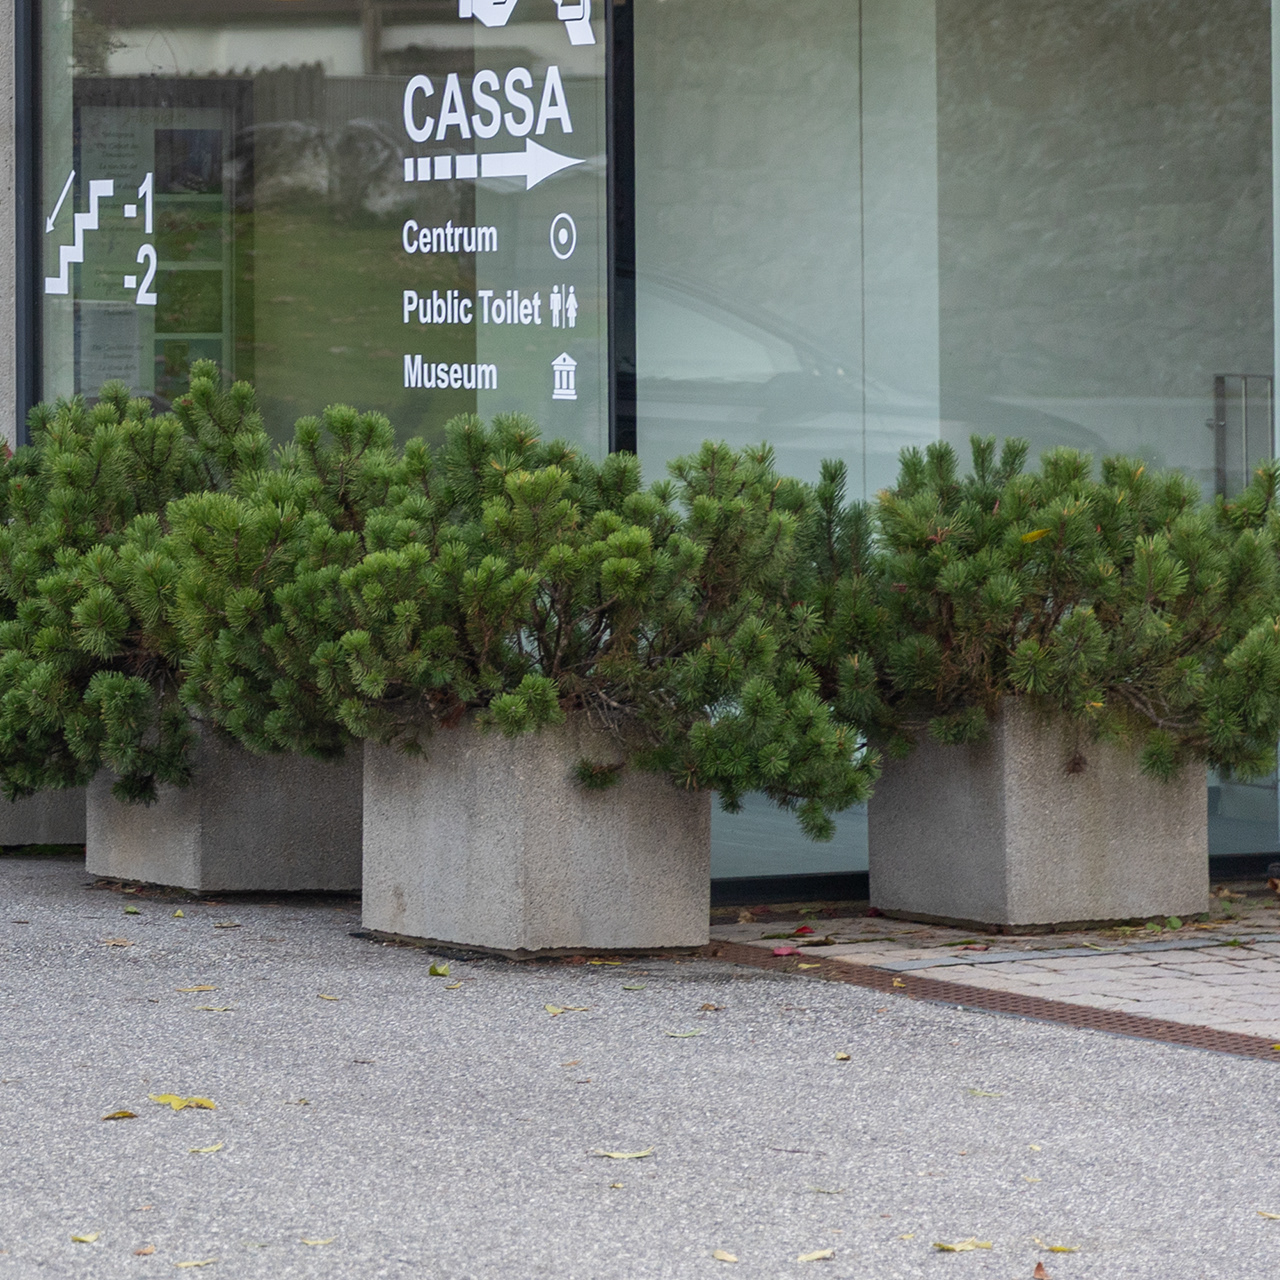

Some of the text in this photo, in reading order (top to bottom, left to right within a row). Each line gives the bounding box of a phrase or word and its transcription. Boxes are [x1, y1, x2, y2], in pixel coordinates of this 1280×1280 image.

[404, 65, 573, 142] CASSA
[124, 172, 153, 234] -1
[403, 220, 498, 253] Centrum
[124, 244, 157, 305] -2
[403, 290, 542, 325] Public Toilet
[404, 354, 498, 390] Museum
